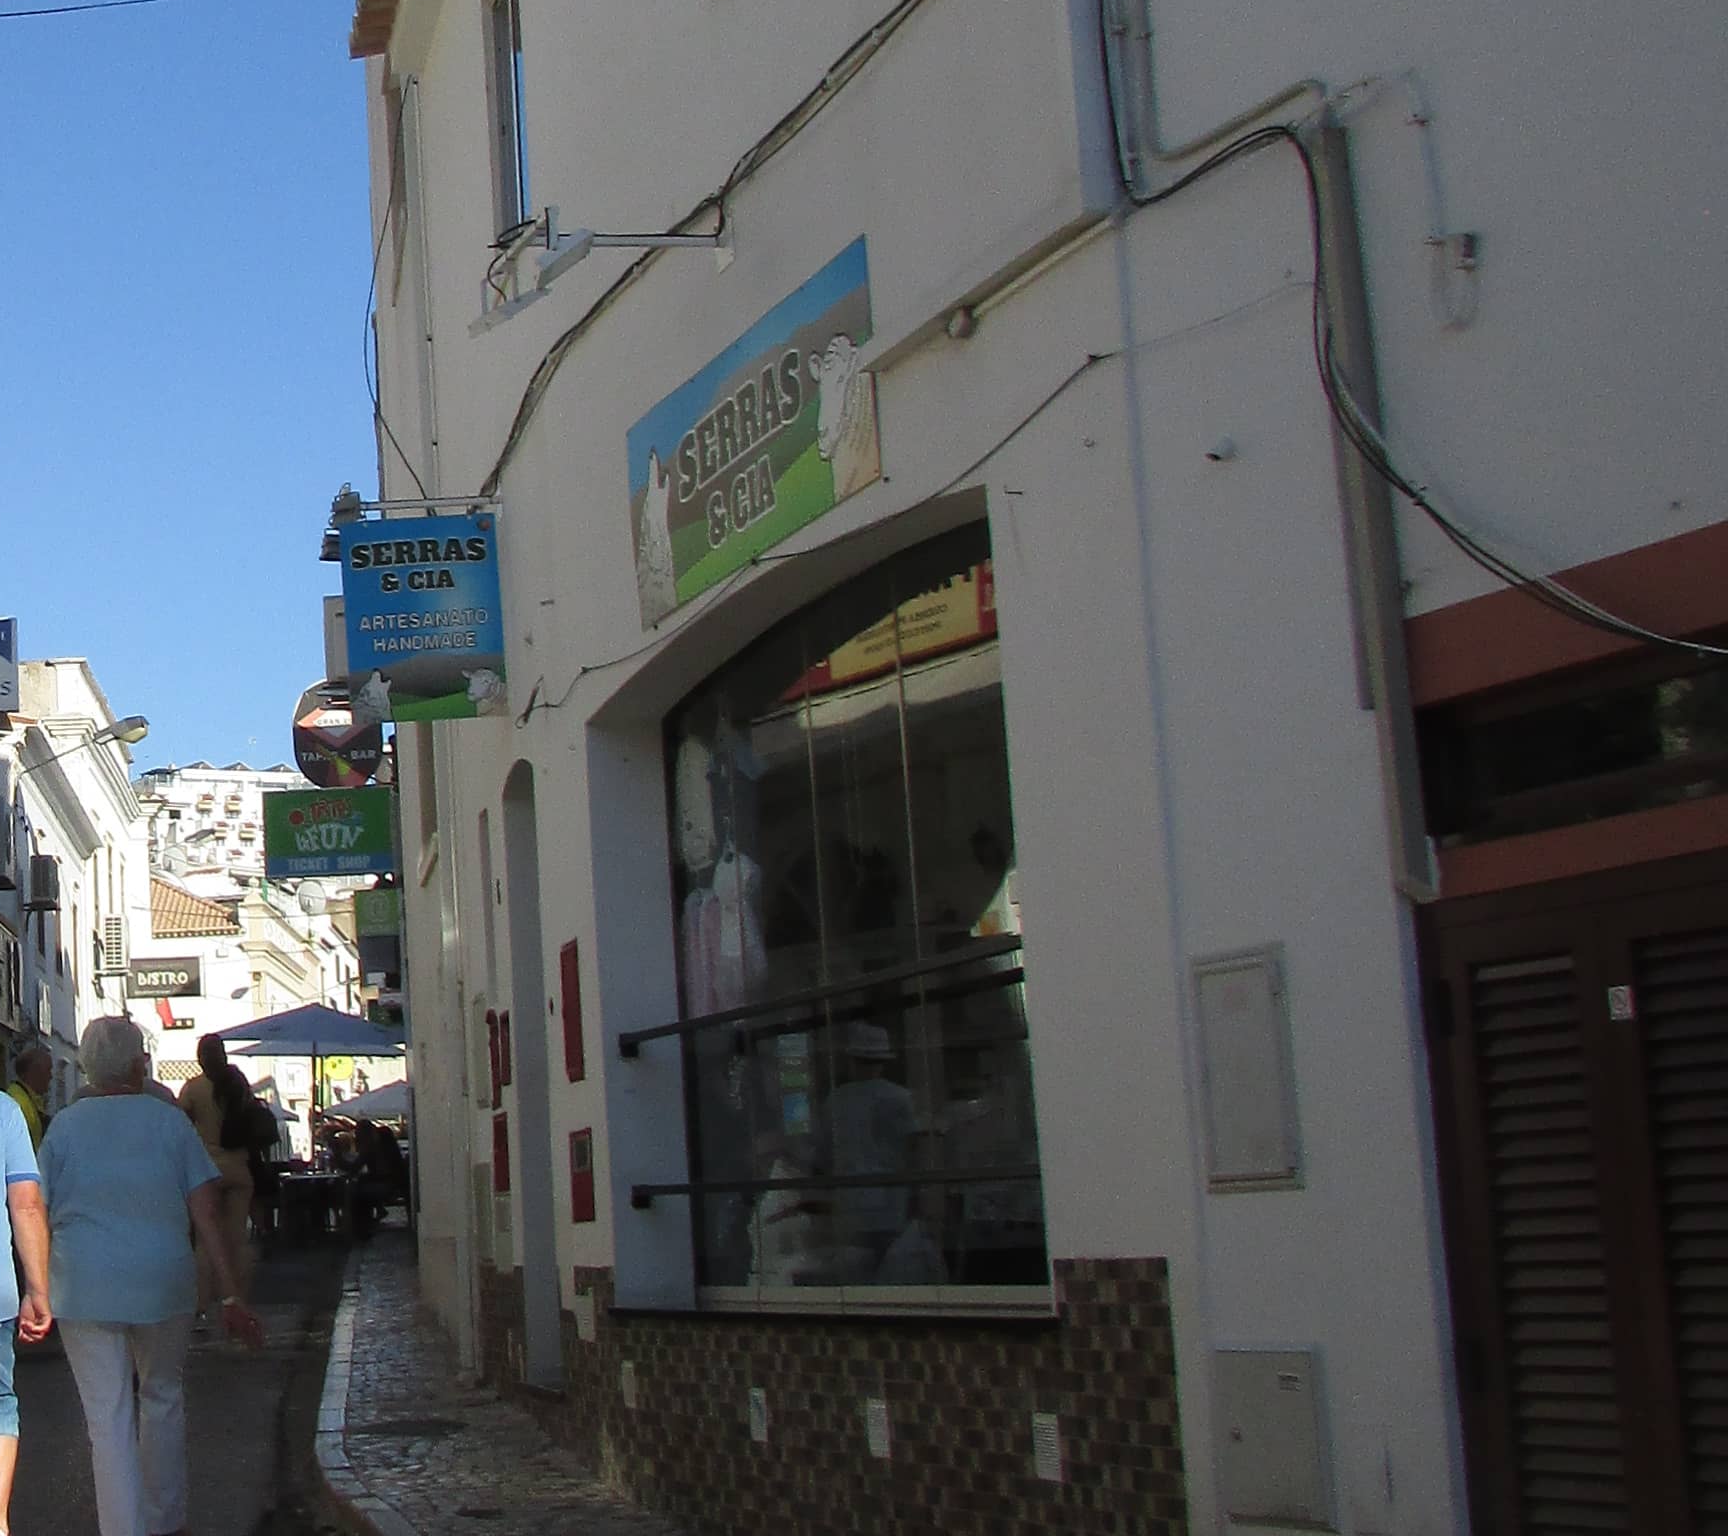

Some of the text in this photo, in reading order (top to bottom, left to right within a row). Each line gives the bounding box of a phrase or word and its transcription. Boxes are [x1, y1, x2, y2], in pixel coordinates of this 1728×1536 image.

[678, 348, 802, 504] SERRAS
[706, 453, 777, 550] & CIA
[350, 536, 487, 570] SERRAS
[380, 568, 457, 593] & CIA
[358, 606, 490, 633] ARTESANATO
[372, 631, 478, 653] HANDMADE
[349, 749, 377, 761] BAR
[287, 856, 330, 873] TICKET
[136, 970, 189, 987] BISTRO
